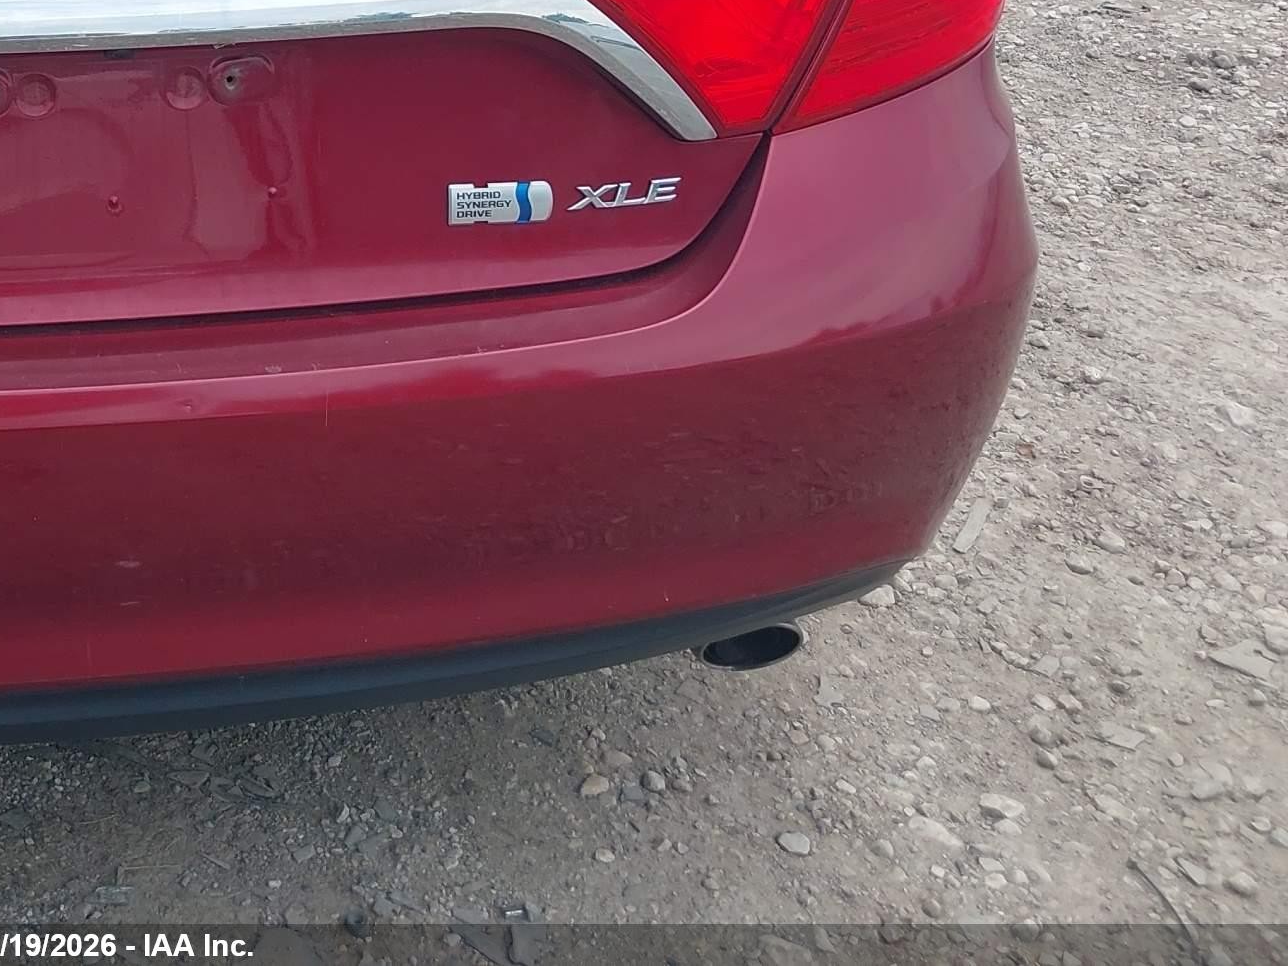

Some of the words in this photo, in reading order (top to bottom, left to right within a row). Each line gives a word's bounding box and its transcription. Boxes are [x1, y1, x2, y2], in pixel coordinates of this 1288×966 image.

[456, 191, 501, 200] HYBRID
[567, 177, 682, 211] XLE
[456, 199, 512, 209] SYNERGY
[456, 209, 492, 219] DRIVE
